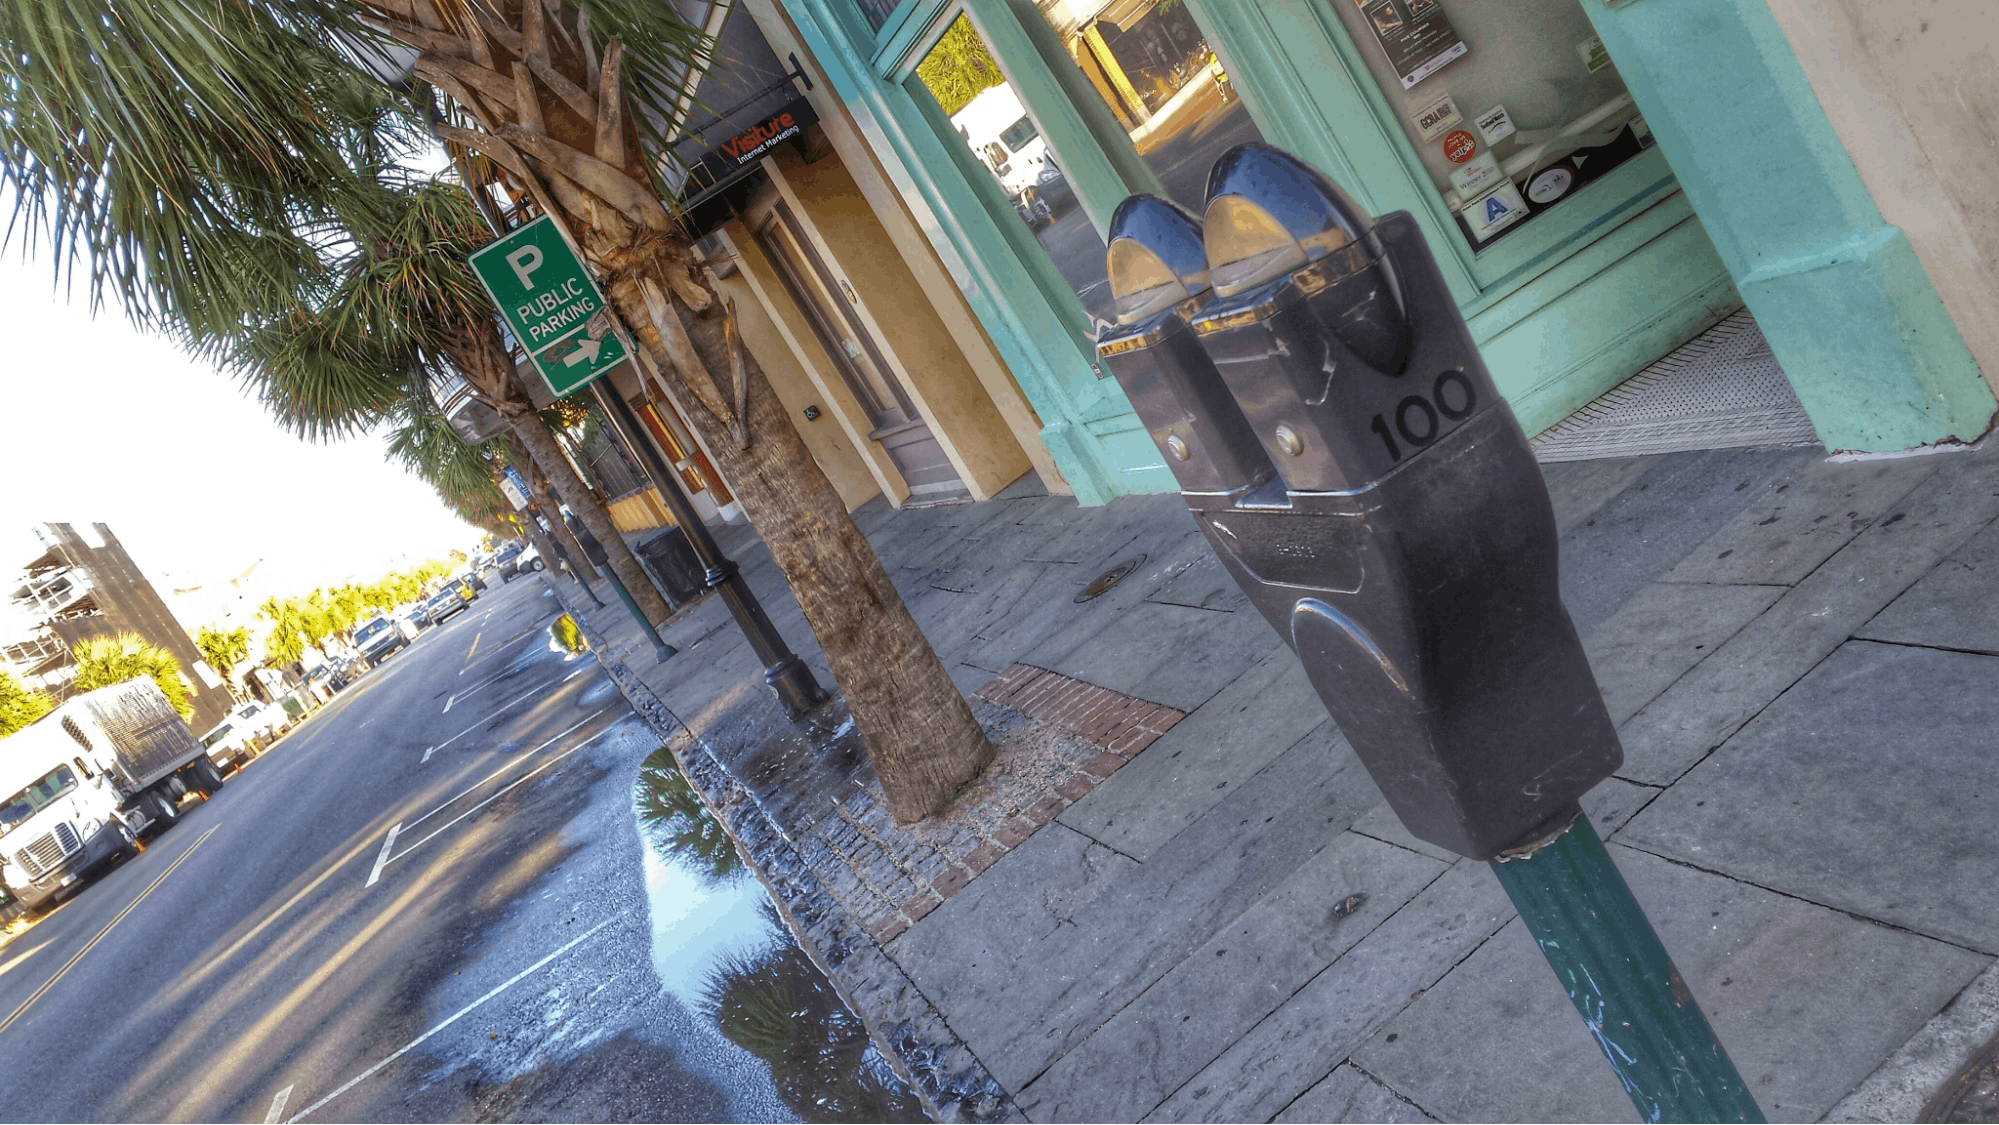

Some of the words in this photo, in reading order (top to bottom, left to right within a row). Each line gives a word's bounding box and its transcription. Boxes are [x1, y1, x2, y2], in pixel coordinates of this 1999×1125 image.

[721, 113, 795, 158] Visiture
[737, 144, 766, 165] Internet
[765, 125, 800, 148] Marketing
[1450, 145, 1469, 161] yelp
[1486, 197, 1508, 222] A
[505, 244, 544, 291] P
[516, 277, 583, 325] PUBLIC
[529, 296, 595, 342] PARKING
[1371, 369, 1477, 463] 100
